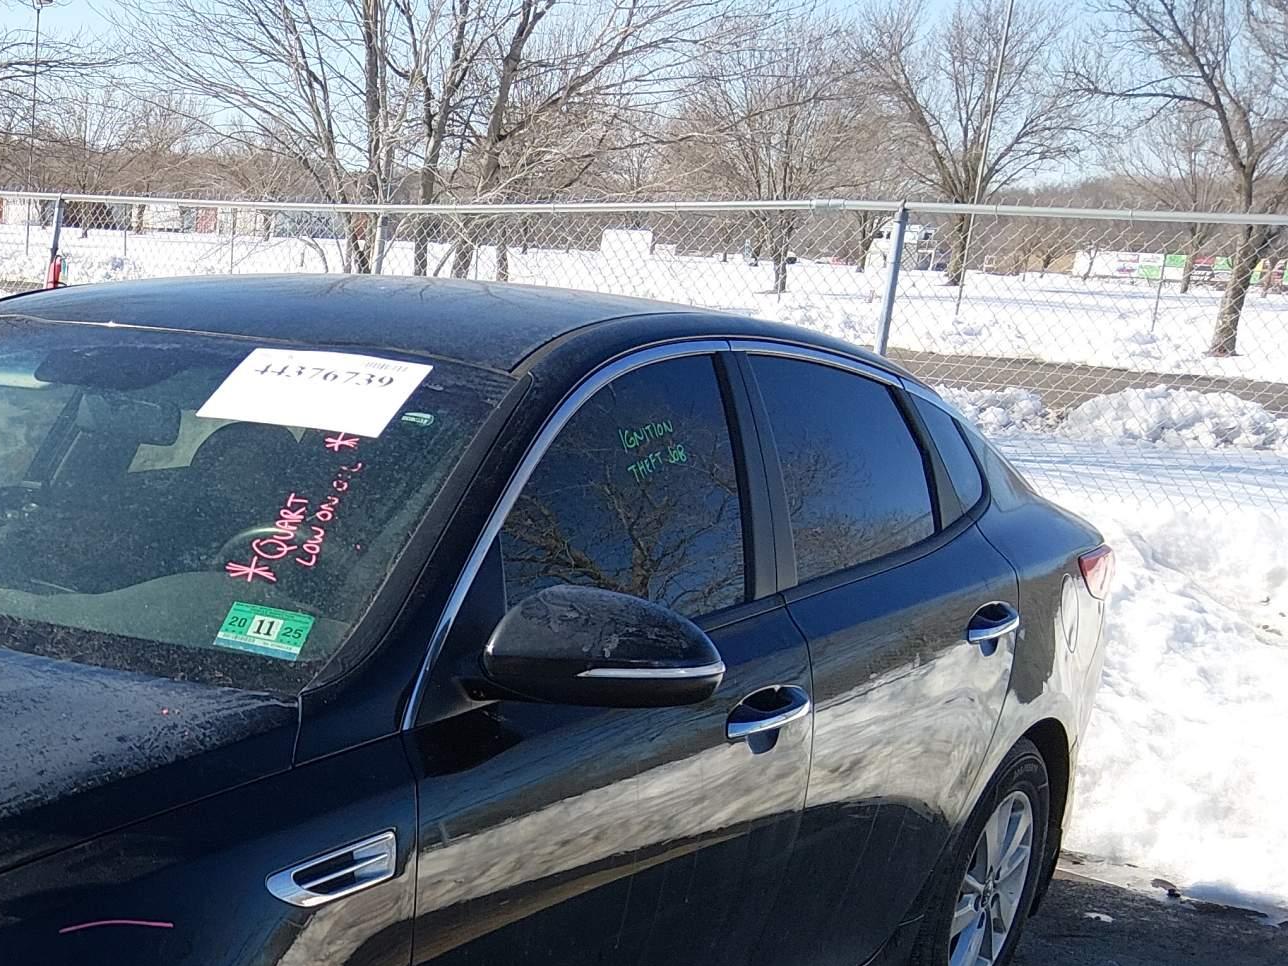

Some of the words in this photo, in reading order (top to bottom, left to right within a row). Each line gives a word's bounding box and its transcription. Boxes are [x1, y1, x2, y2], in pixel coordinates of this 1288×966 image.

[254, 363, 395, 388] 44376739
[618, 420, 674, 453] IGNITION
[627, 451, 663, 484] THEFT
[667, 444, 688, 464] JOB
[295, 526, 325, 567] LOW
[228, 615, 248, 629] 20
[253, 618, 276, 637] 11
[281, 626, 304, 640] 25
